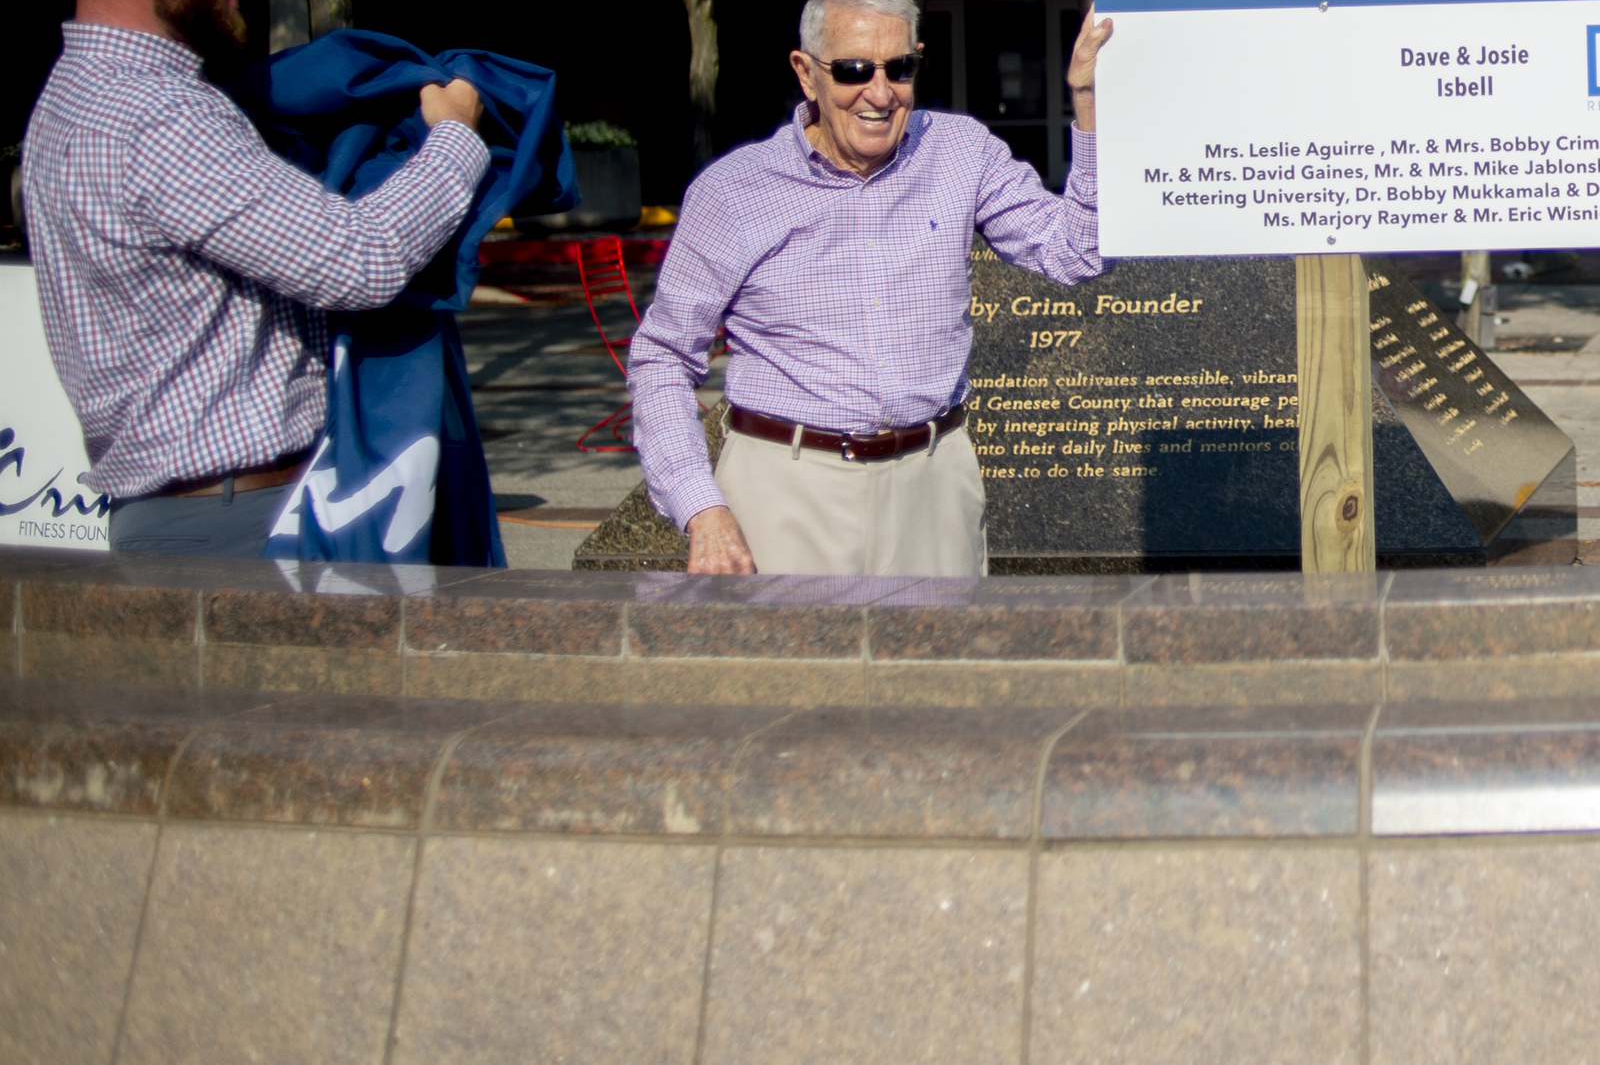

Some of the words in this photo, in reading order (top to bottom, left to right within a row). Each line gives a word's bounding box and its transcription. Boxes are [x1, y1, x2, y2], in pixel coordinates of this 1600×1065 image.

[1401, 48, 1450, 66] Dave
[1457, 46, 1470, 65] &
[1476, 44, 1528, 65] Josie
[1438, 76, 1492, 97] Isbell
[1206, 144, 1243, 158] Mrs.
[1250, 142, 1300, 157] Leslie
[1391, 140, 1419, 154] Mr.
[1426, 139, 1439, 153] &
[1446, 139, 1484, 153] Mrs.
[1491, 136, 1550, 154] Bobby
[1145, 169, 1173, 183] Mr.
[1179, 168, 1191, 182] &
[1199, 168, 1236, 181] Mrs.
[1243, 165, 1294, 180] David
[1301, 164, 1368, 180] Gaines,
[1375, 164, 1403, 178] Mr.
[1409, 163, 1422, 177] &
[1429, 163, 1468, 176] Mrs.
[1474, 160, 1518, 175] Mike
[1163, 190, 1246, 208] Kettering
[1253, 188, 1349, 206] University,
[1356, 188, 1381, 201] Dr.
[1387, 185, 1446, 204] Bobby
[1453, 183, 1560, 199] Mukkamala
[1567, 183, 1579, 197] &
[1264, 213, 1294, 226] Ms.
[1301, 211, 1372, 229] Marjory
[1378, 211, 1447, 228] Raymer
[1454, 209, 1467, 223] &
[1474, 208, 1502, 222] Mr.
[1509, 207, 1542, 221] Eric
[1011, 296, 1082, 316] Crim,
[1095, 293, 1203, 315] Founder
[1030, 330, 1082, 348] 1977
[1056, 372, 1137, 387] cultivates
[1145, 370, 1234, 386] accessible,
[988, 396, 1060, 410] Genesee
[1068, 395, 1132, 412] County
[1139, 394, 1174, 408] that
[1181, 396, 1271, 411] encourage
[977, 418, 997, 437] by
[1004, 419, 1099, 437] integrating
[1107, 416, 1178, 435] physical
[1013, 440, 1055, 455] their
[1062, 440, 1106, 458] daily
[1113, 439, 1151, 454] lives
[1159, 439, 1192, 453] and
[1200, 441, 1271, 453] mentors
[1024, 466, 1040, 478] to
[1048, 463, 1069, 477] do
[1077, 463, 1104, 477] the
[19, 521, 66, 538] FITNESS
